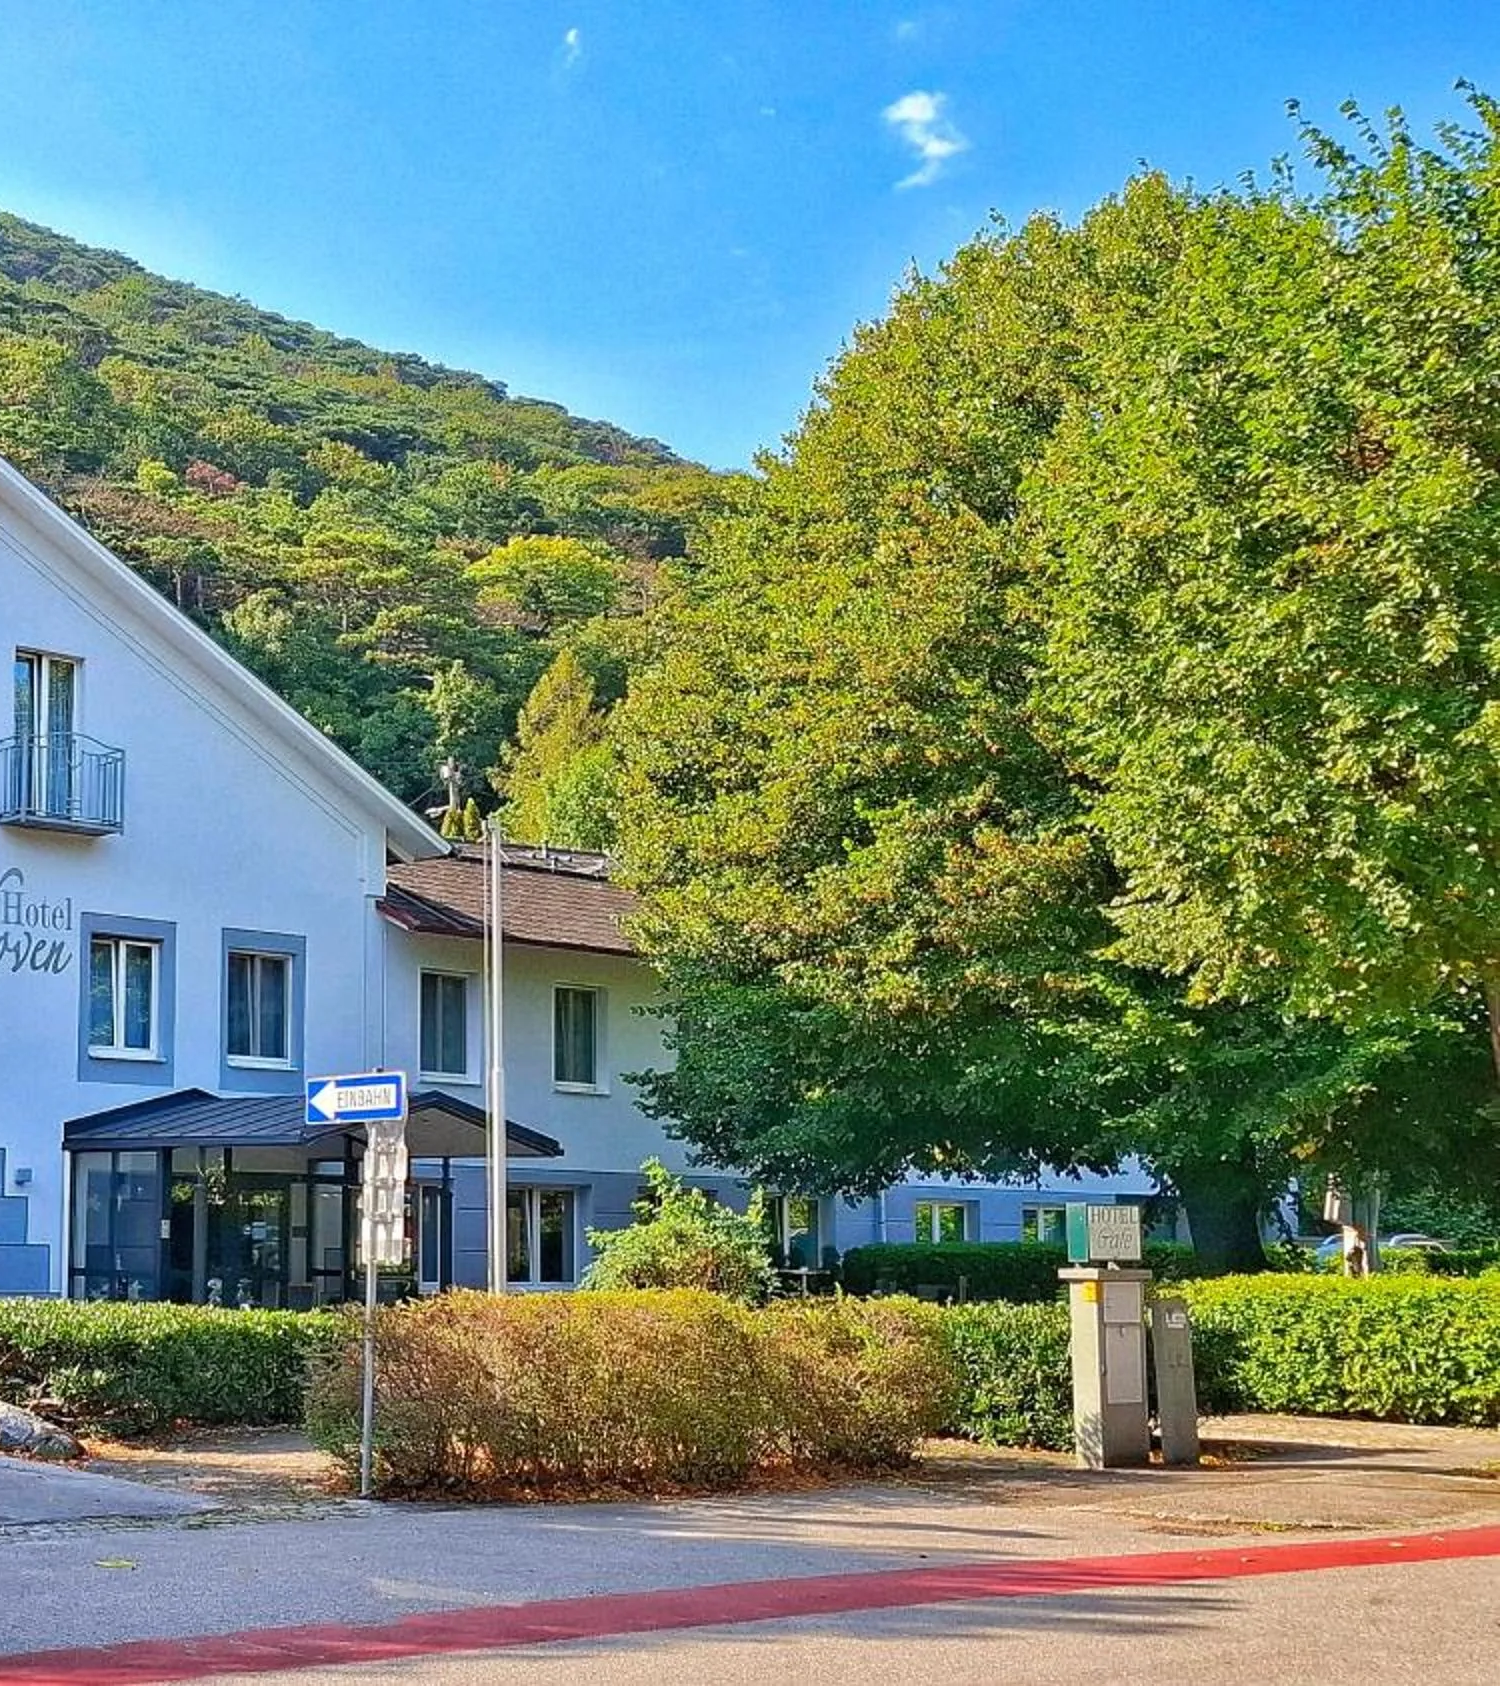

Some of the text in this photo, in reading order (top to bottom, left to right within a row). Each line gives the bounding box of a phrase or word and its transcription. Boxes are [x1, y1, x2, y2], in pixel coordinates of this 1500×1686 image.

[1, 889, 73, 930] Hotel
[336, 1086, 392, 1109] EINBAHN
[1091, 1206, 1138, 1225] HOTEL
